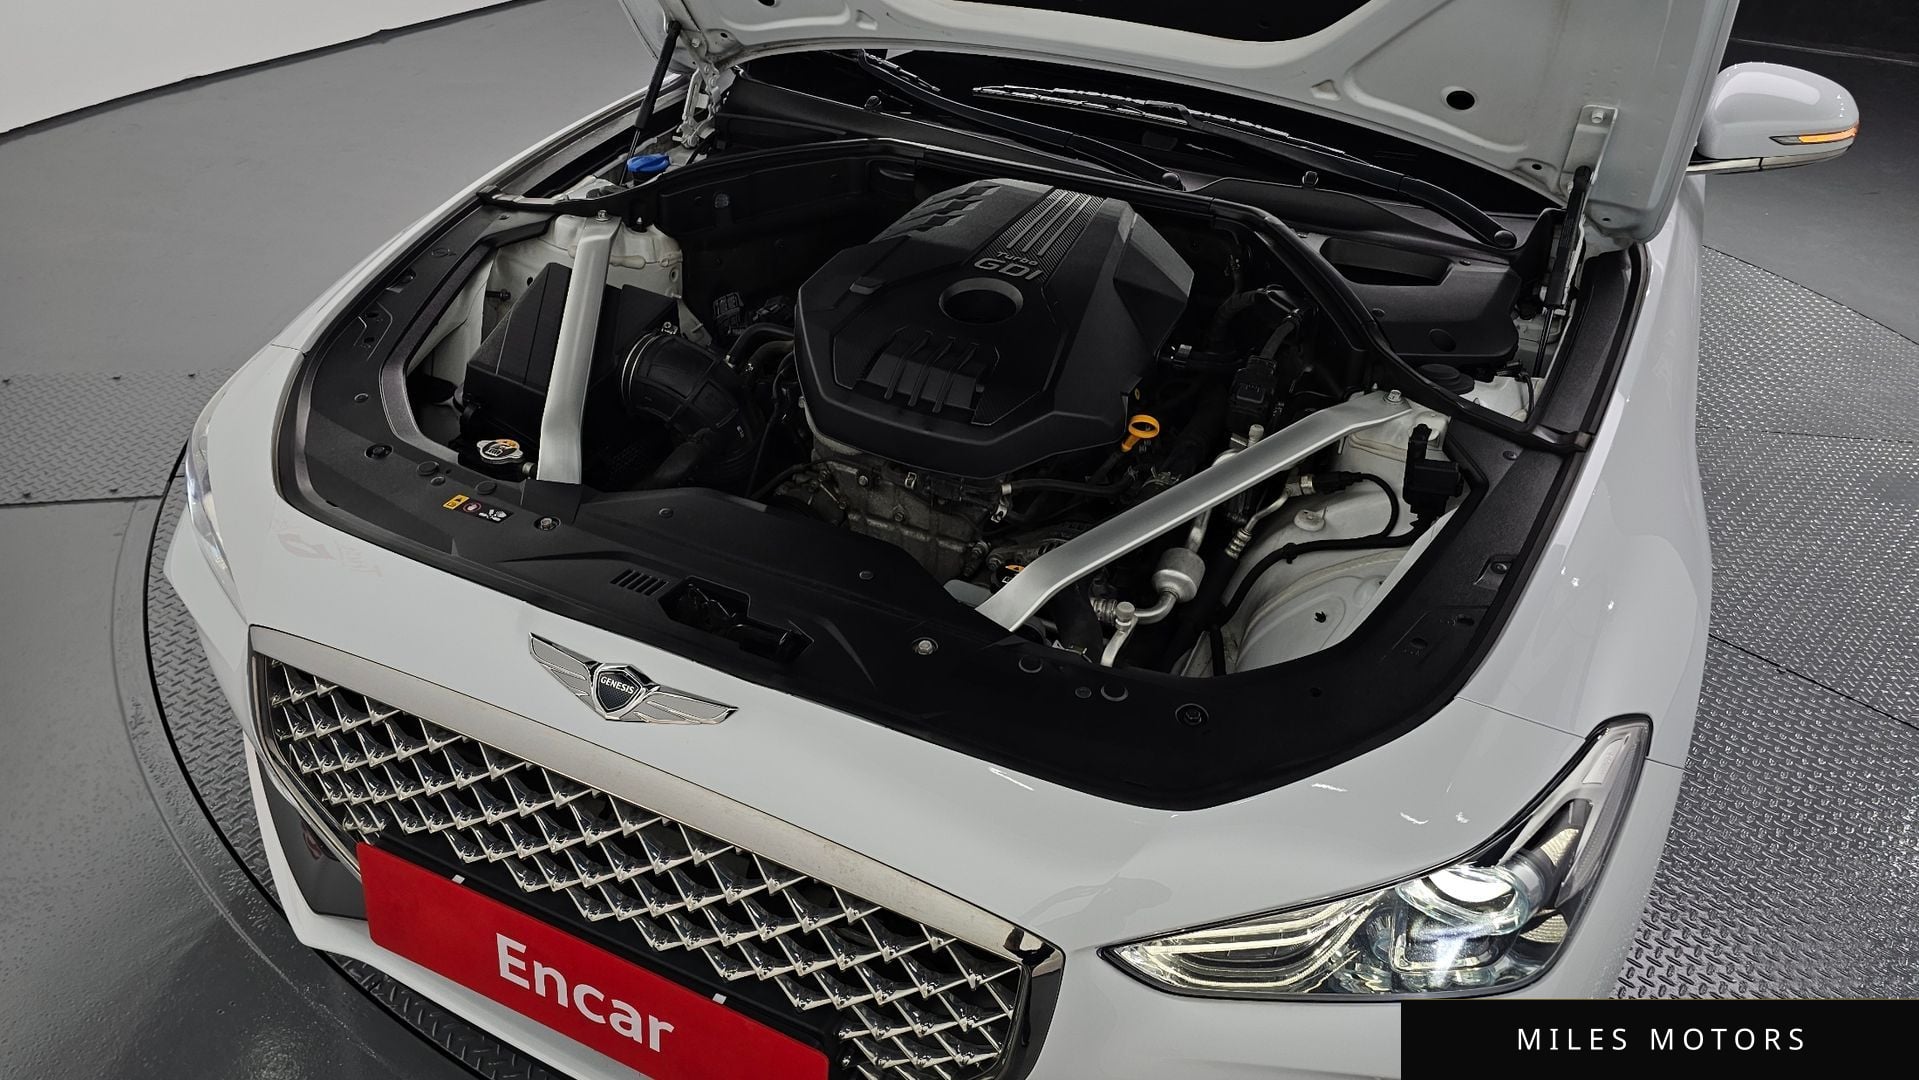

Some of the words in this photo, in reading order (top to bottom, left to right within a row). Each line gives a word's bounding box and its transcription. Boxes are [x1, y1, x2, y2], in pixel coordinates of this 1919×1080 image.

[974, 257, 1042, 280] GDI
[600, 676, 635, 694] GENESIS
[496, 932, 675, 1053] Encar
